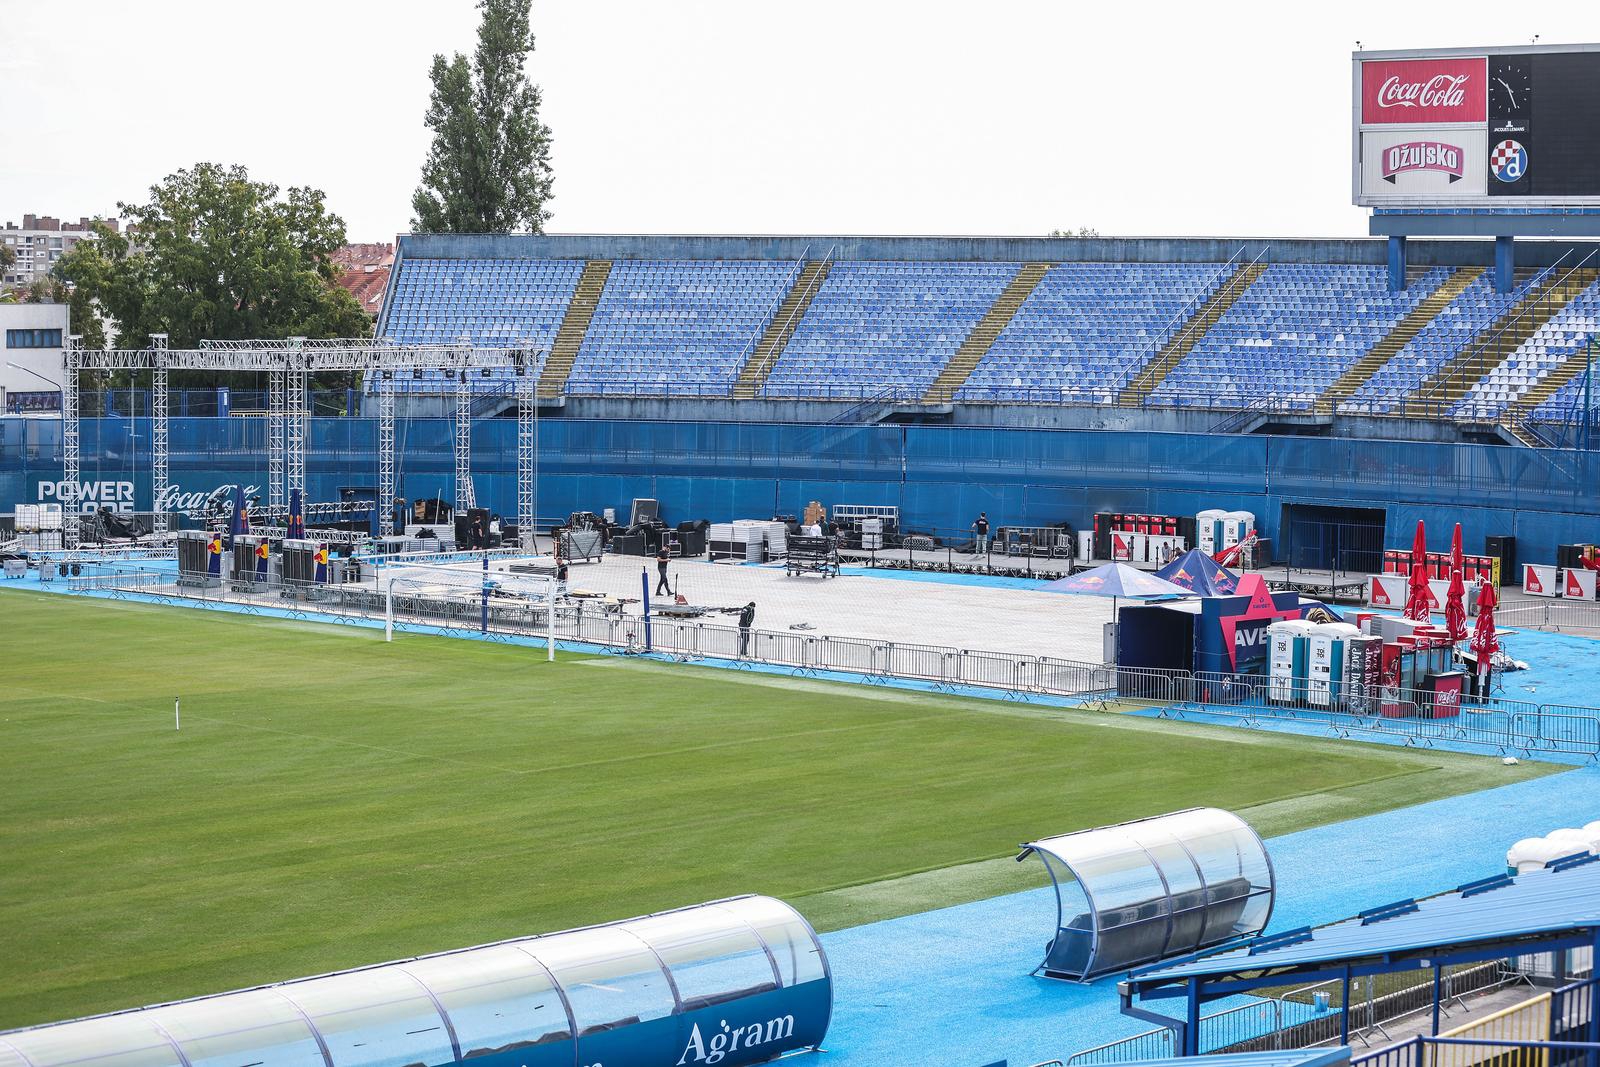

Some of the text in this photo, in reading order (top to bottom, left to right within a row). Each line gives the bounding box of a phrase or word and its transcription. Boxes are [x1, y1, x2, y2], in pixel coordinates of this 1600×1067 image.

[1377, 74, 1470, 107] Coca-Cola
[1389, 143, 1458, 170] Ožujsko
[38, 481, 134, 500] POWER
[676, 1014, 795, 1066] Agram
